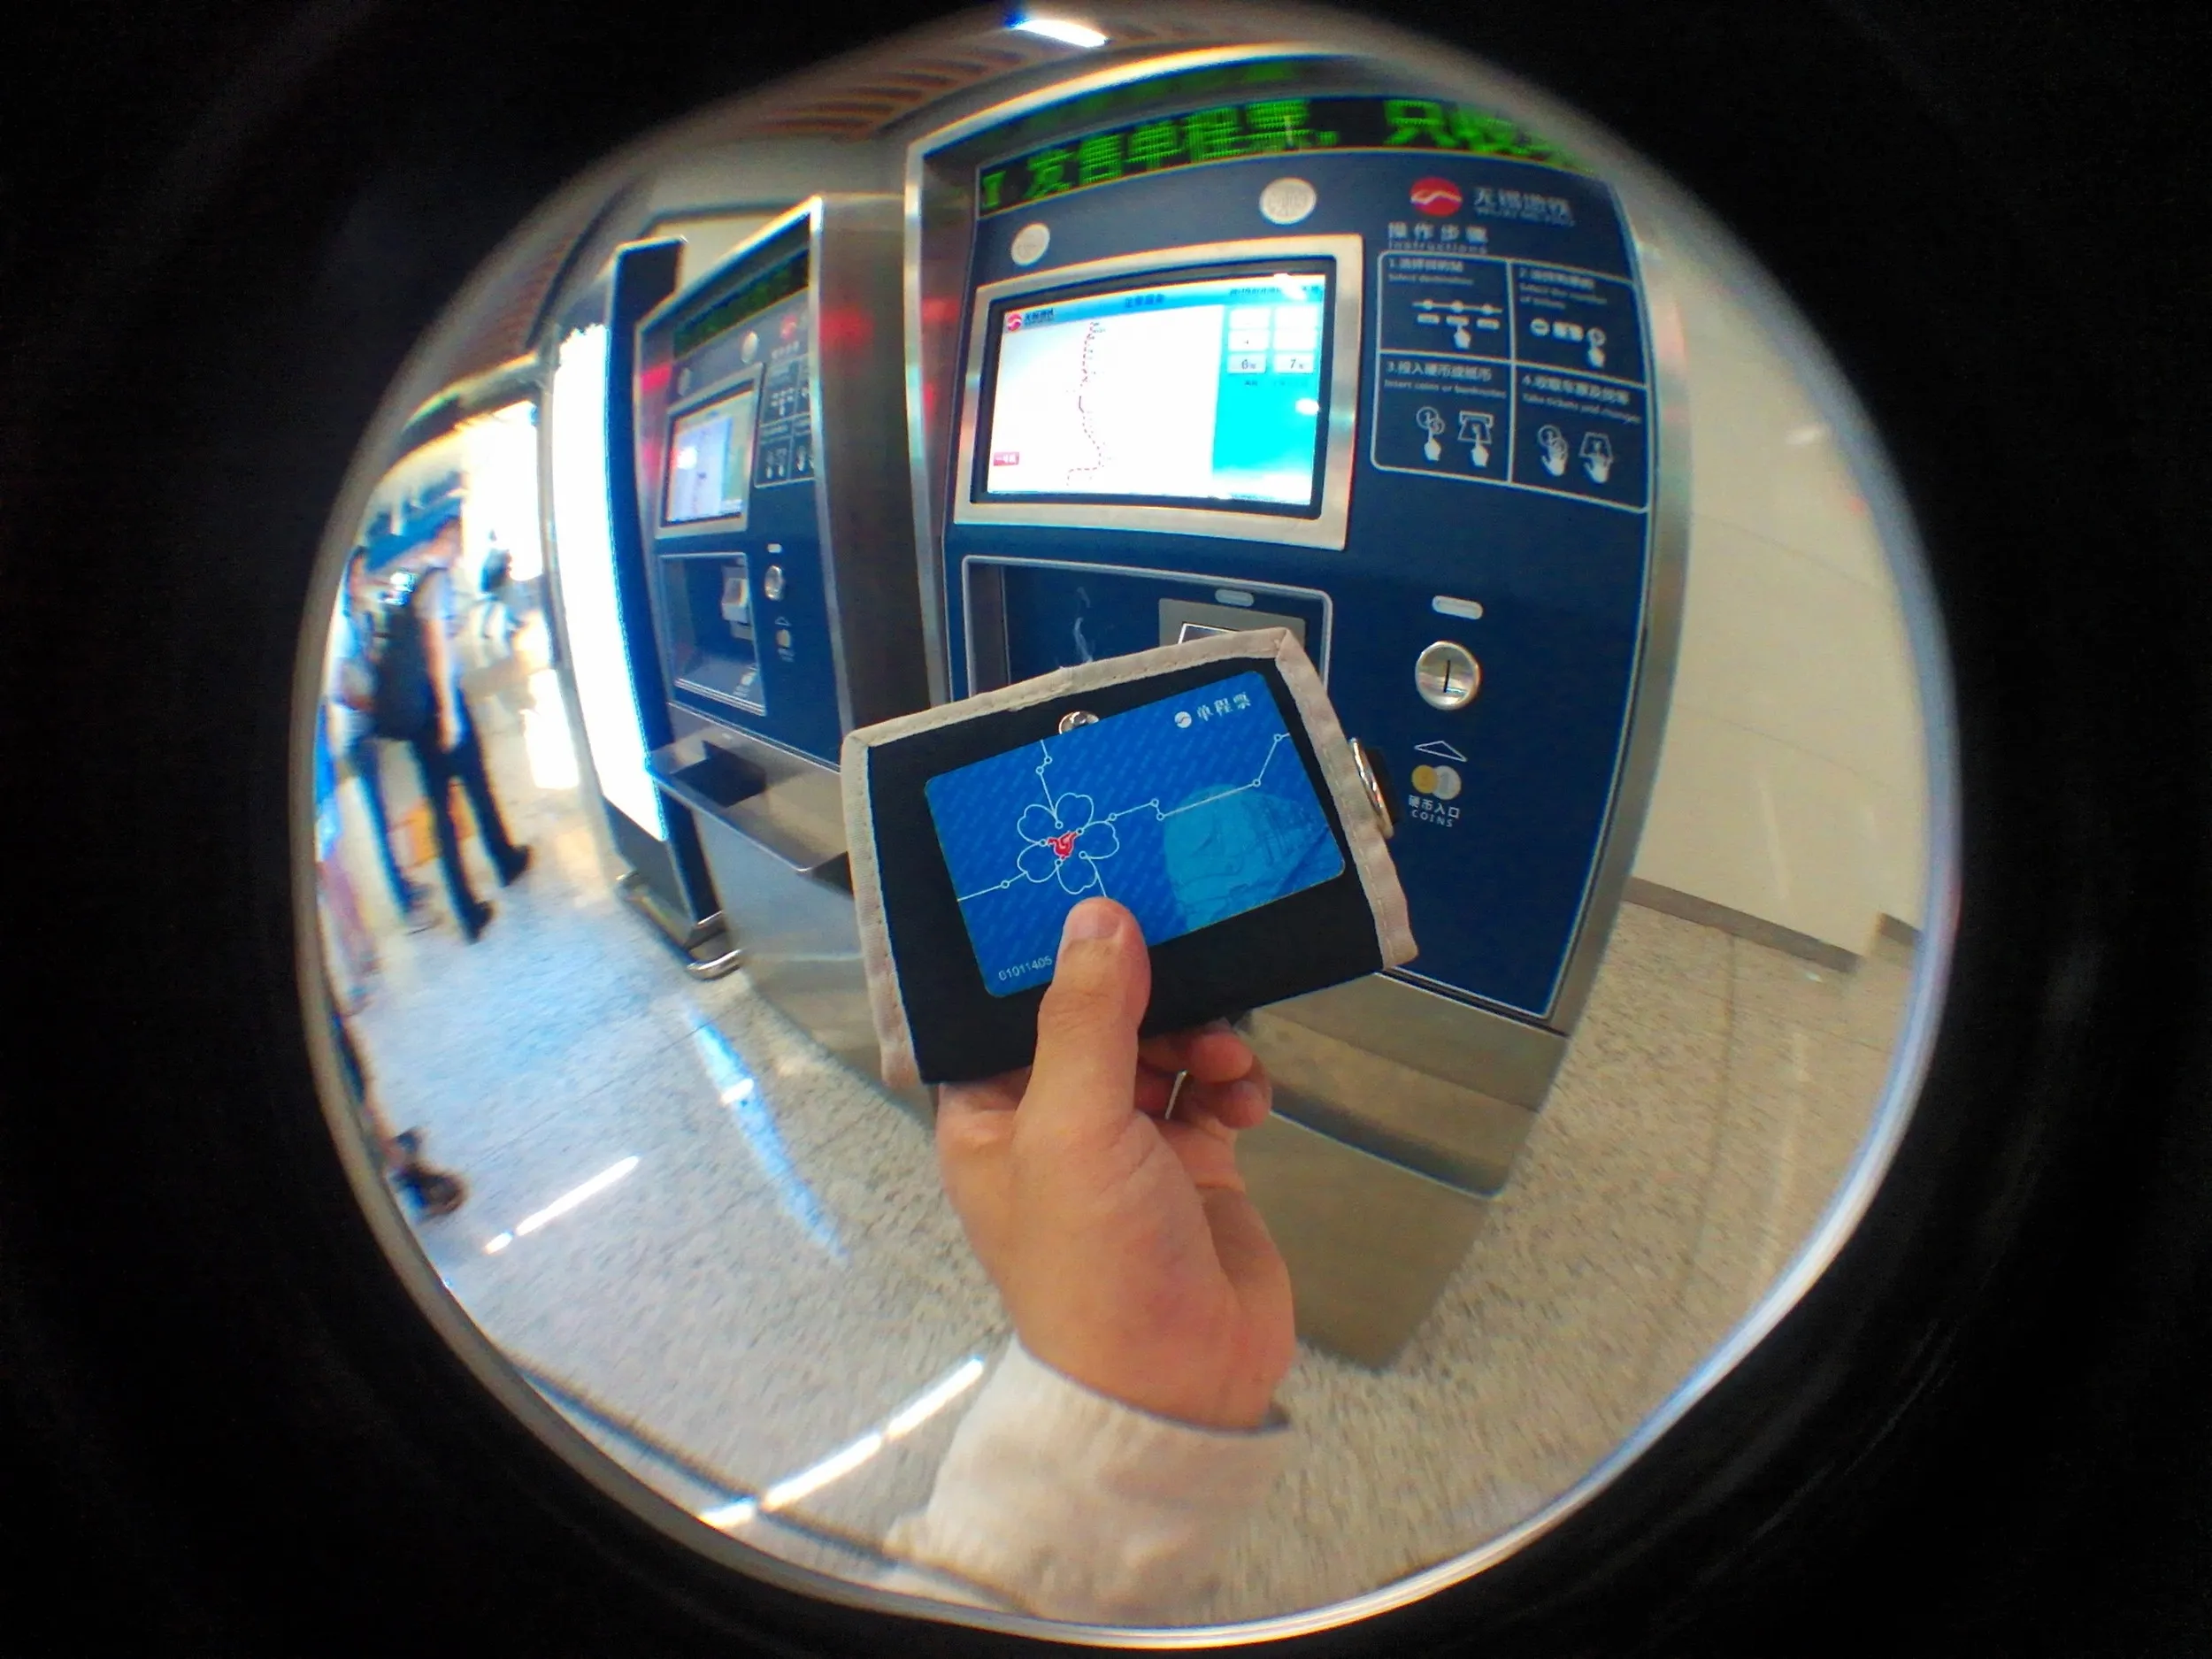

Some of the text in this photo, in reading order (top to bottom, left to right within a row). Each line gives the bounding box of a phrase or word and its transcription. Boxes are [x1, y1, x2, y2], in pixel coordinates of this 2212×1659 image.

[1196, 692, 1251, 721] 单程票
[1409, 795, 1461, 819] 硬币入口
[1411, 809, 1454, 828] COINS
[998, 956, 1053, 981] 01011405
